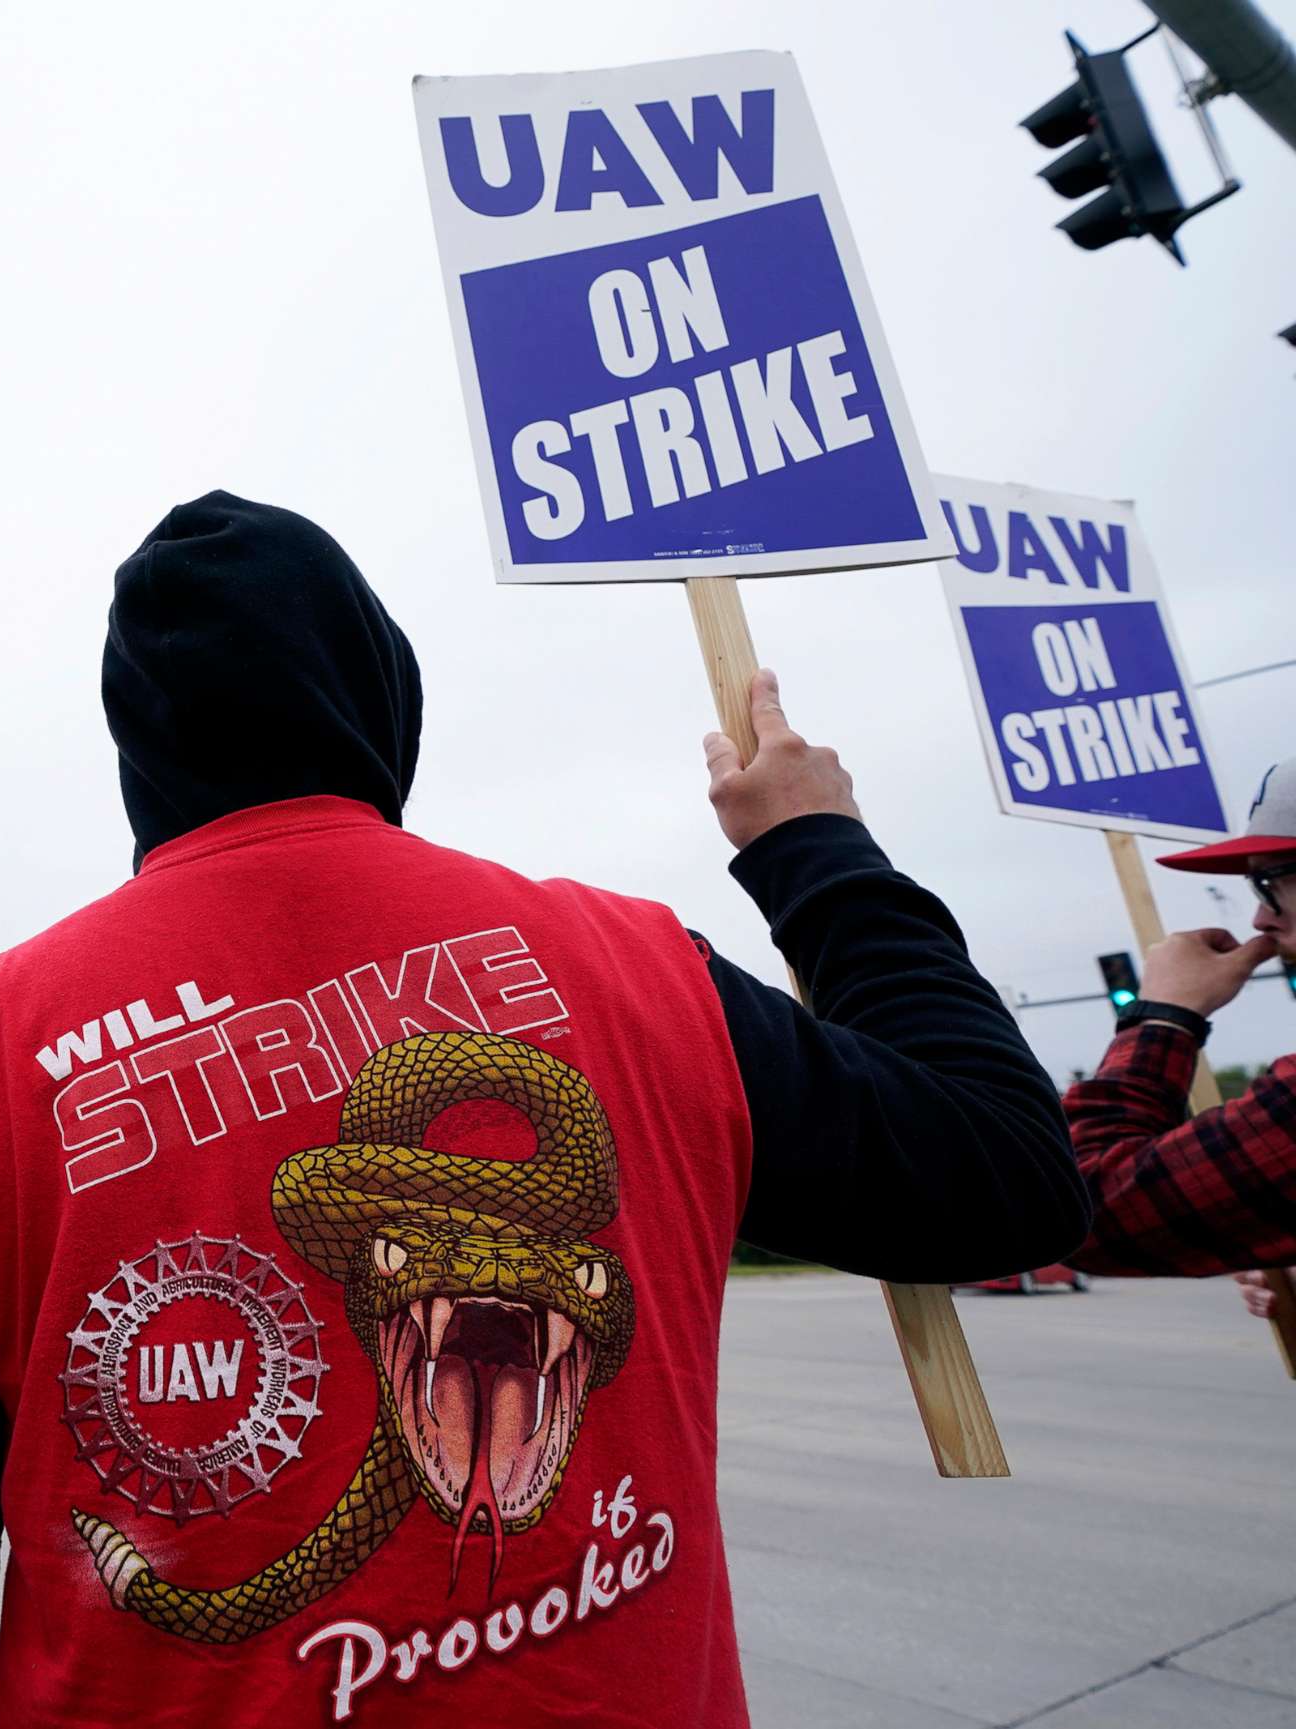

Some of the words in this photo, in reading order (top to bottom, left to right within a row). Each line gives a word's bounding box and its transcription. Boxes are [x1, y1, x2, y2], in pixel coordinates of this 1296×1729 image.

[438, 88, 775, 218] UAW
[588, 245, 730, 379] ON
[511, 329, 875, 541] STRIKE
[939, 499, 1131, 593] UAW
[1031, 617, 1118, 697] ON
[1001, 690, 1201, 792] STRIKE
[35, 981, 236, 1081] WILL
[53, 925, 570, 1195] STRIKE
[101, 1312, 137, 1378] AEROSPACE
[132, 1291, 158, 1316] AND
[138, 1339, 245, 1404] UAW
[260, 1357, 287, 1419] WORKERS
[196, 1435, 250, 1472] AMERICA
[249, 1419, 267, 1440] OF
[591, 1474, 638, 1539] if
[297, 1510, 675, 1721] Provoked
